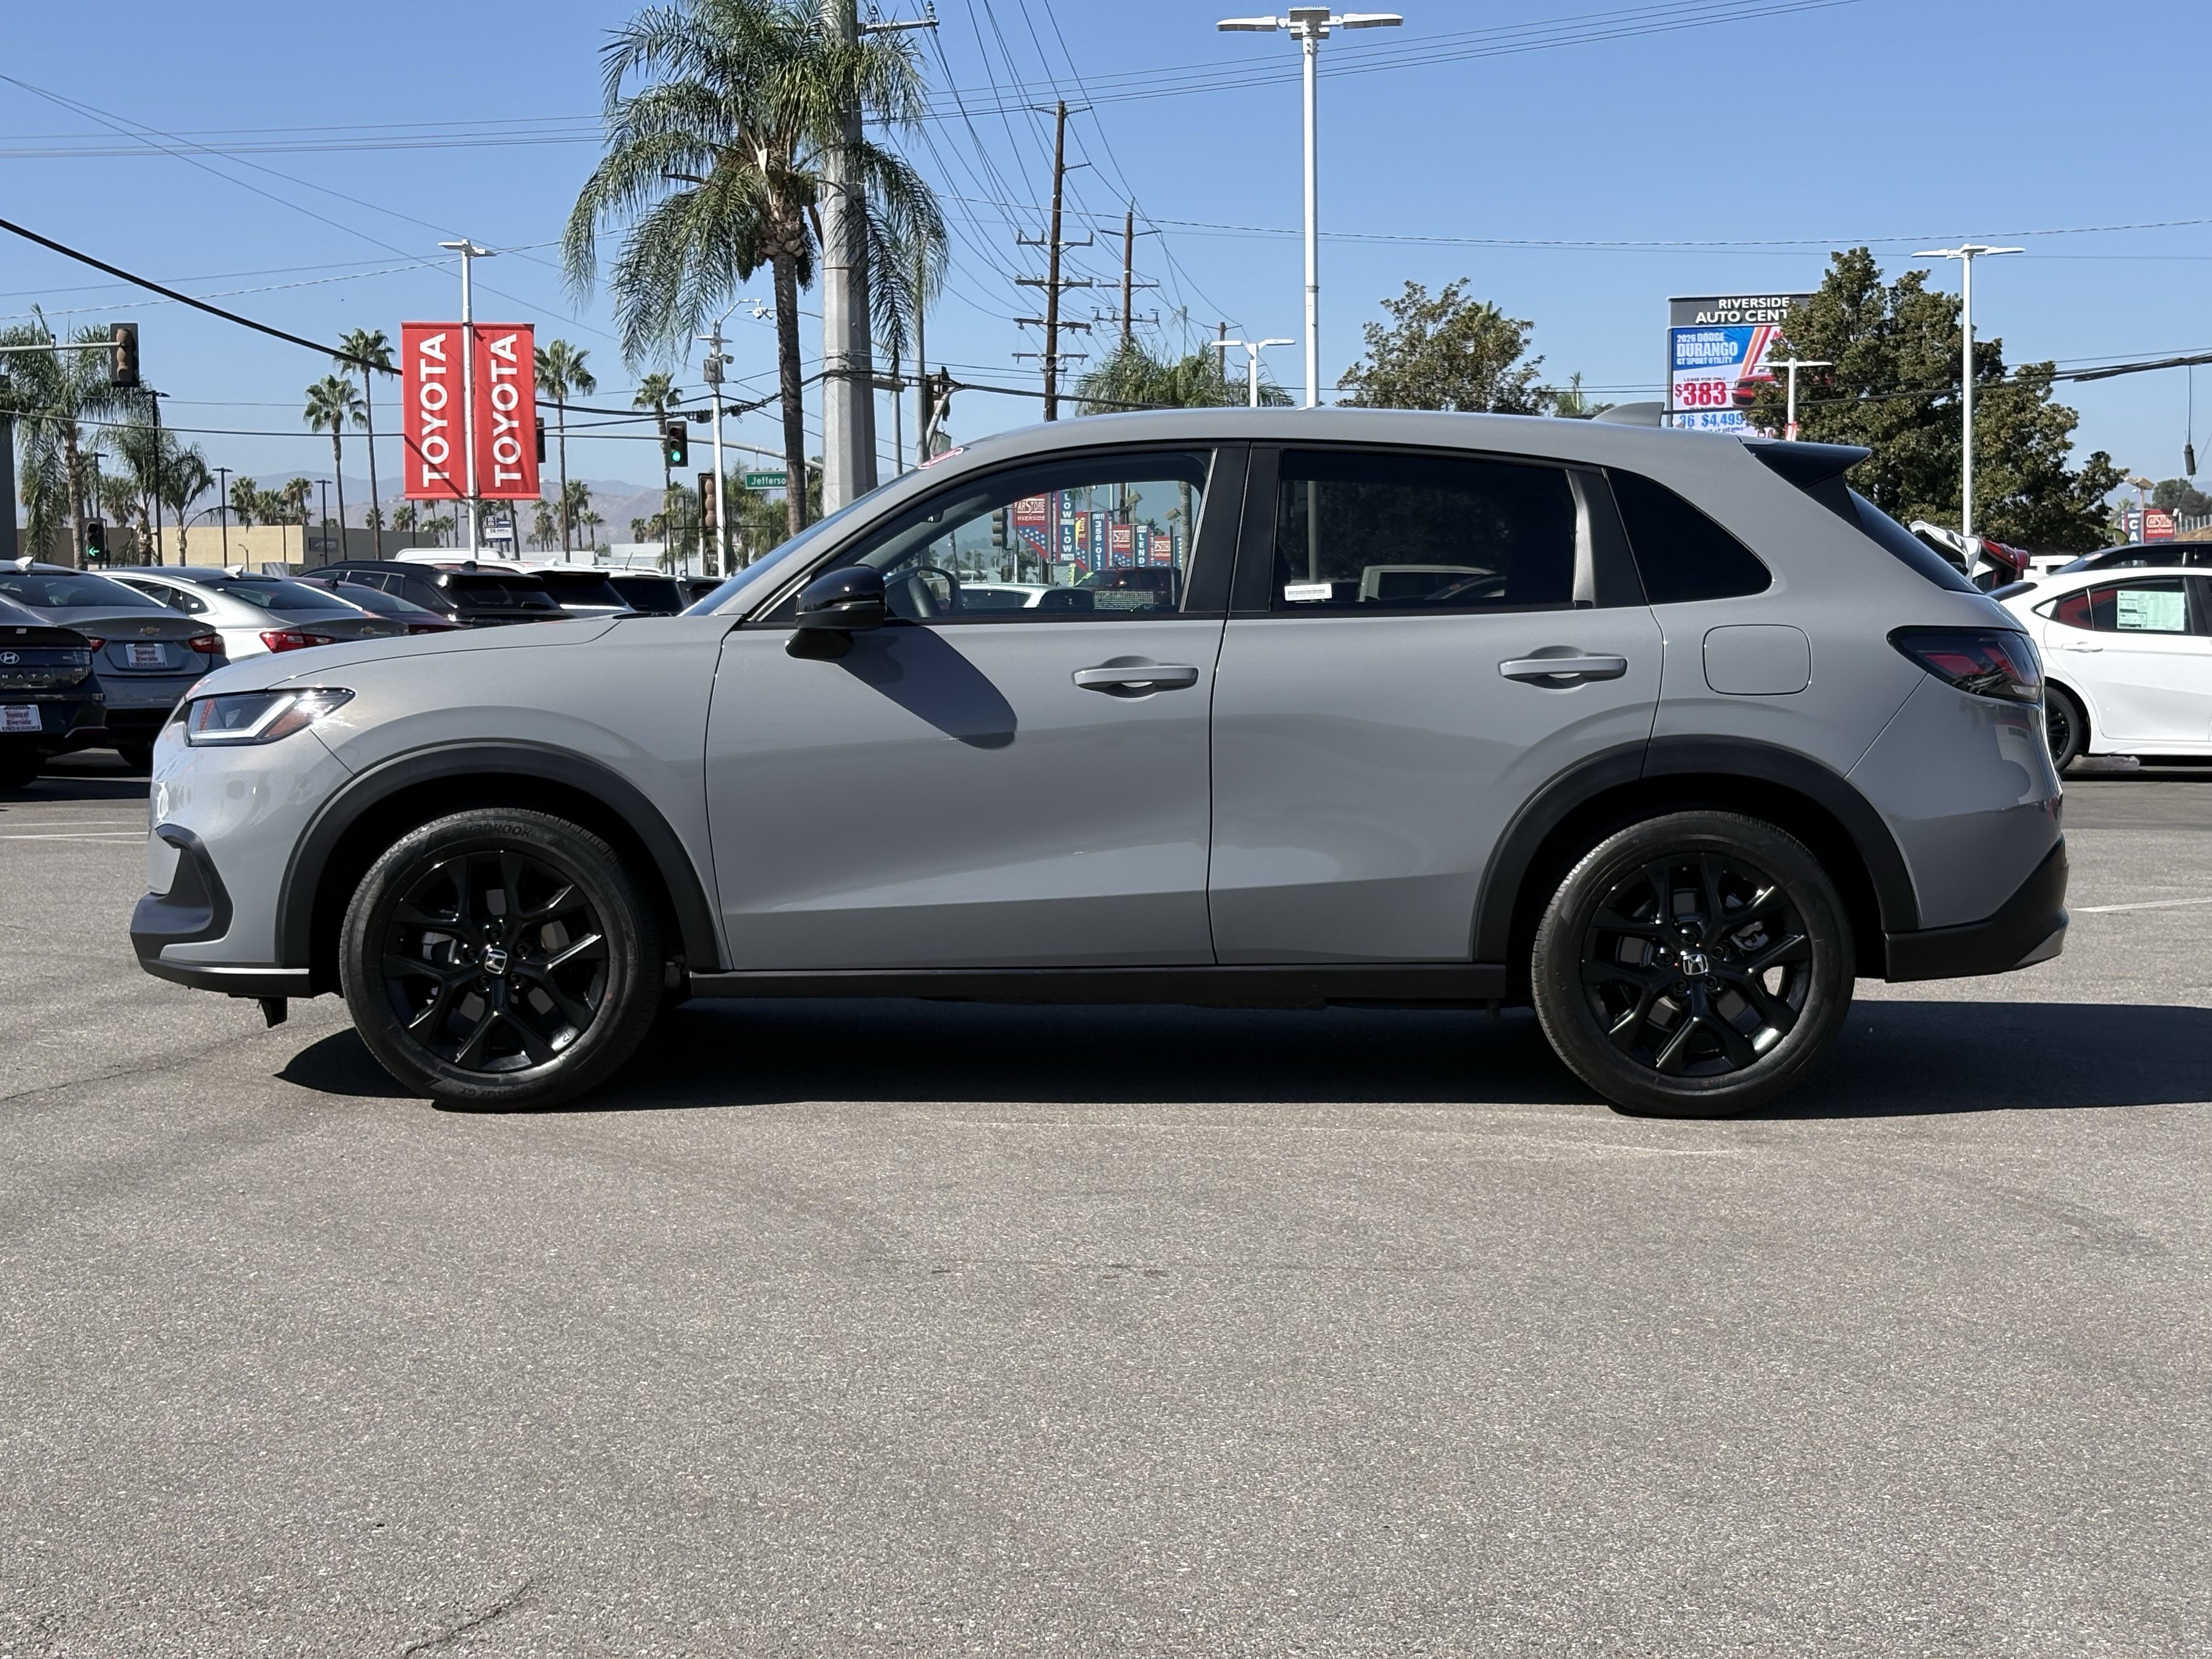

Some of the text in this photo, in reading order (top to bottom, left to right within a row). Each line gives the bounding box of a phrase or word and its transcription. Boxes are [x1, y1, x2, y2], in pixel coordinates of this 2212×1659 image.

[1718, 297, 1790, 309] RIVERSIDE
[1695, 309, 1788, 324] AUTO CENT
[1677, 332, 1725, 343] 2026 DODGE
[1677, 341, 1738, 357] DURANGO
[1674, 381, 1726, 405] $383
[419, 332, 450, 488] TOYOTA
[490, 333, 522, 488] TOYOTA
[1701, 413, 1743, 427] $4,499
[751, 476, 787, 485] Jefferso
[1063, 527, 1072, 553] LOW
